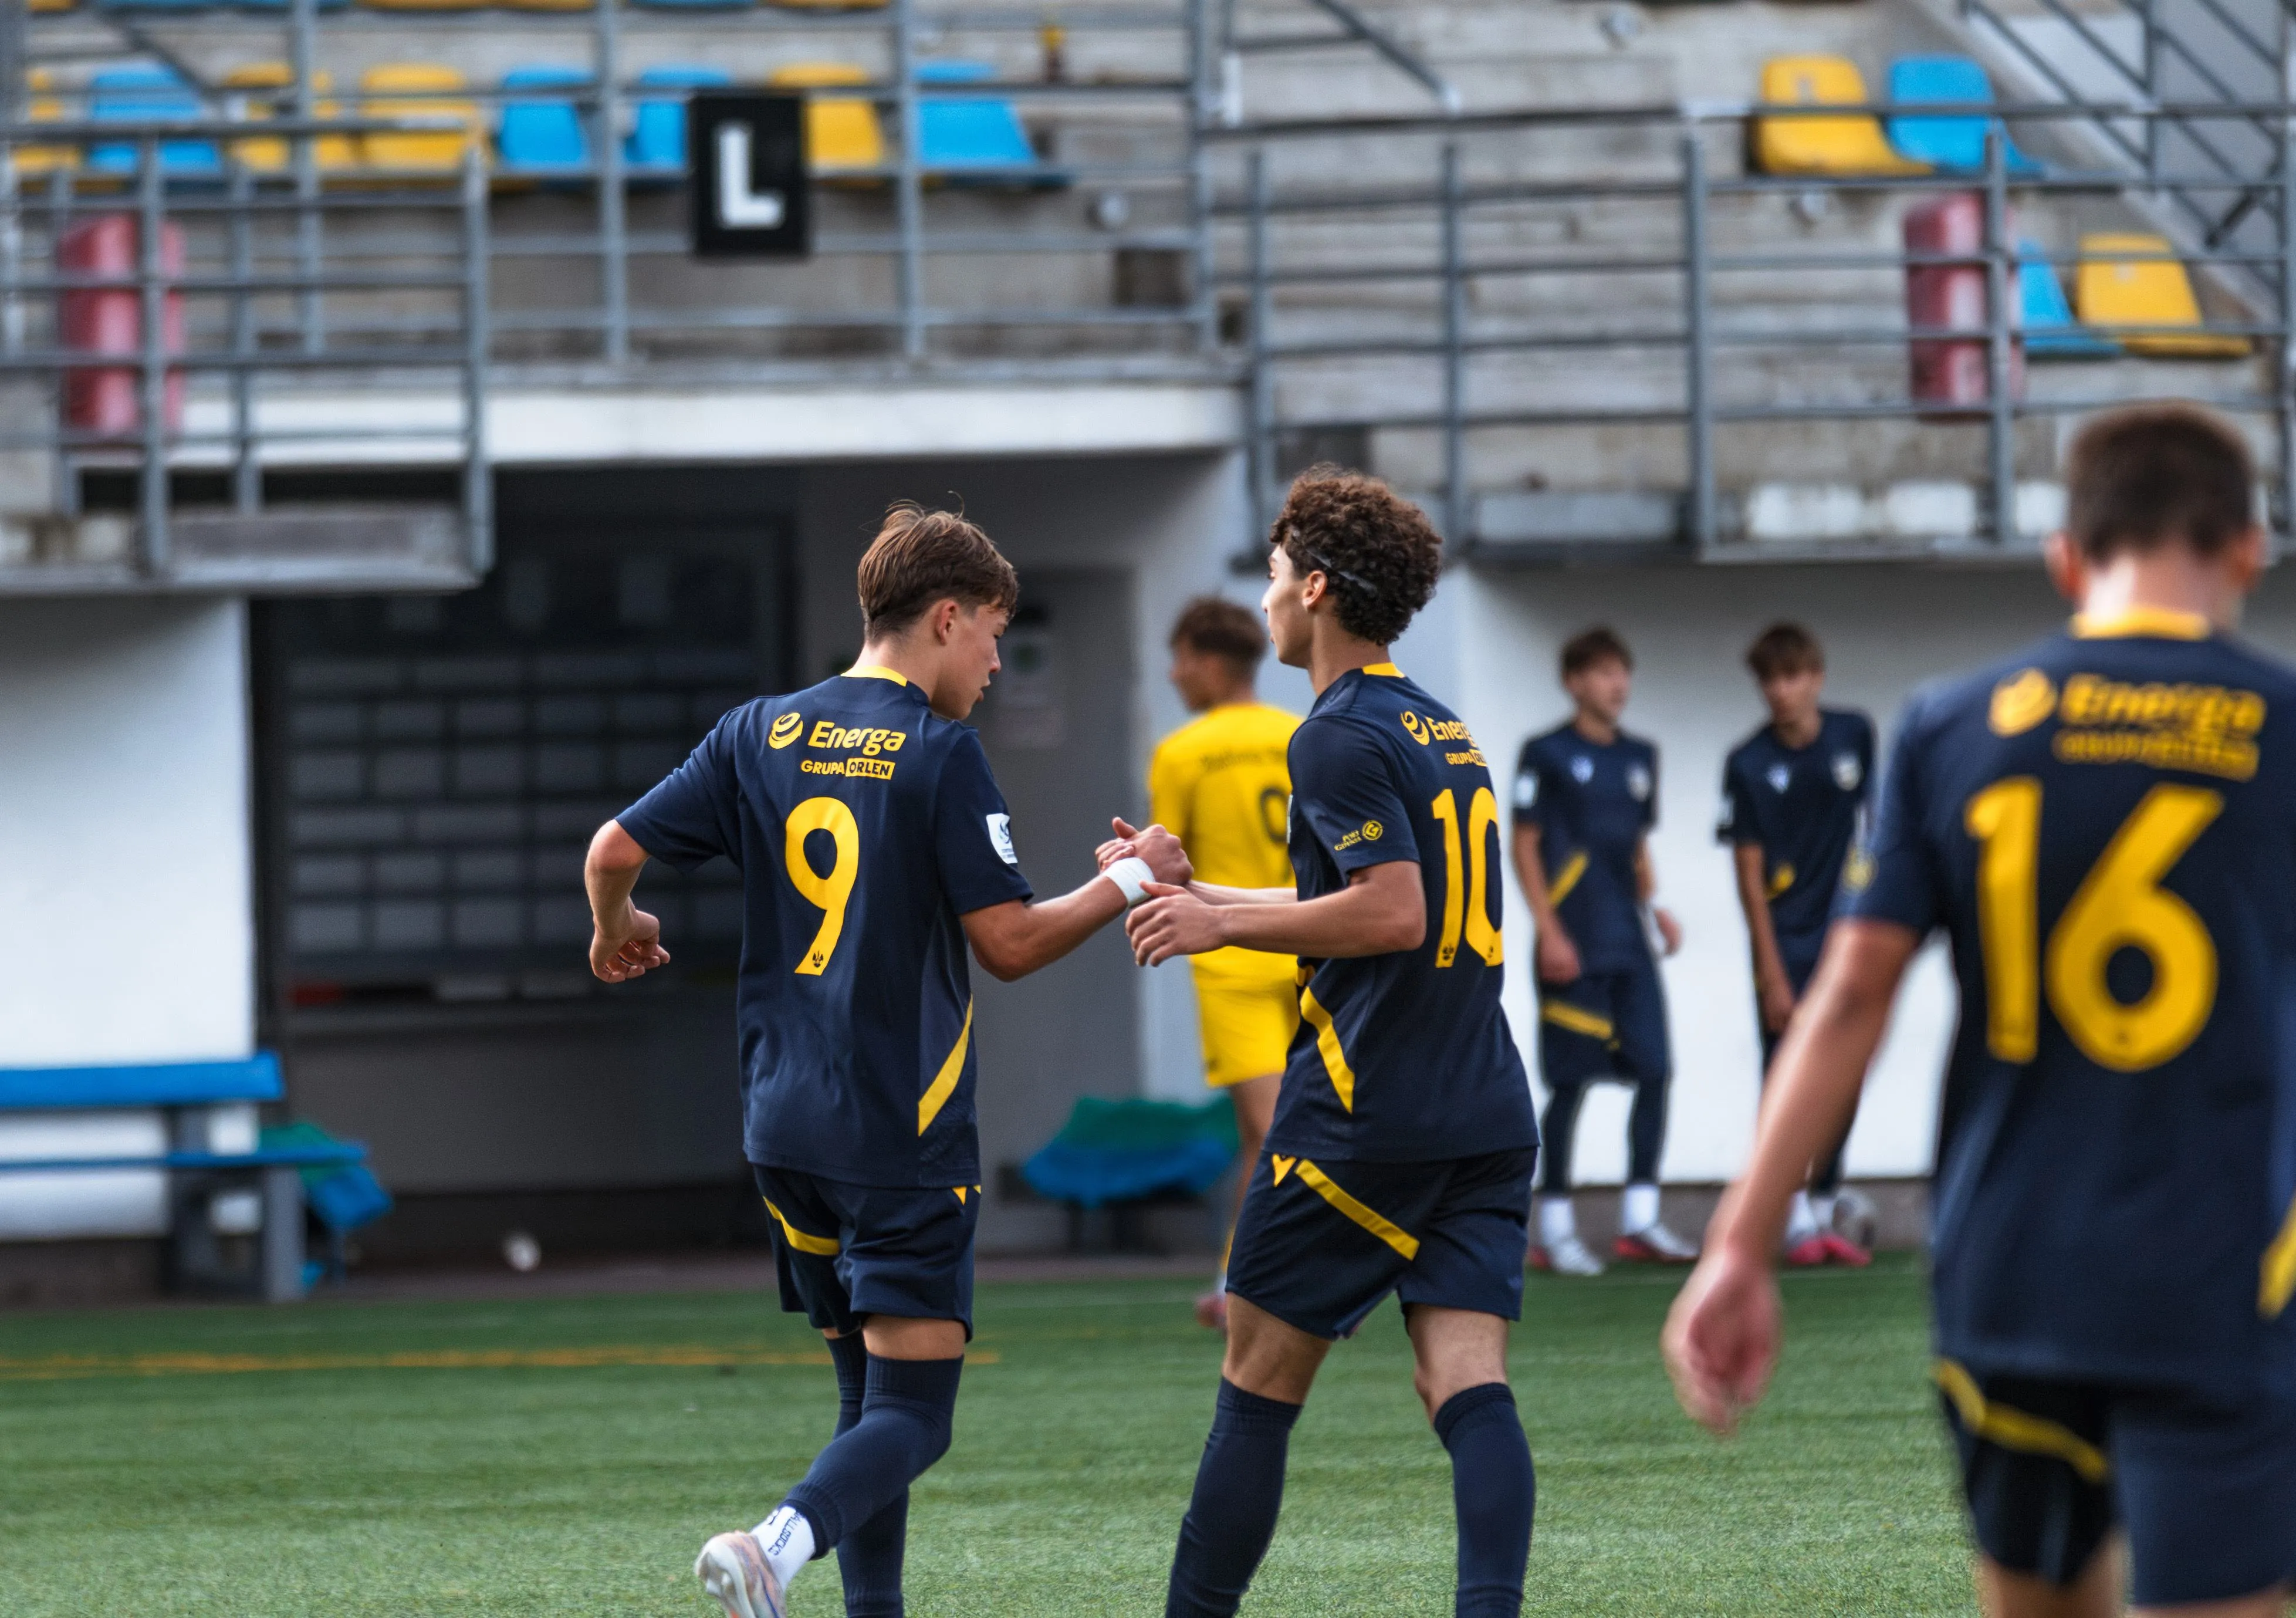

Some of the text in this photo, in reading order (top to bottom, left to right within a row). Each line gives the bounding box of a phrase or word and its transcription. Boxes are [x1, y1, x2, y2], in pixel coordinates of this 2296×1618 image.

[718, 125, 784, 228] L
[800, 759, 891, 776] GRUPA ORLEN
[808, 721, 907, 756] Energa
[1445, 752, 1475, 765] GRUPA
[786, 797, 859, 976] 9
[1431, 787, 1504, 968] 10
[1965, 776, 2224, 1071] 16
